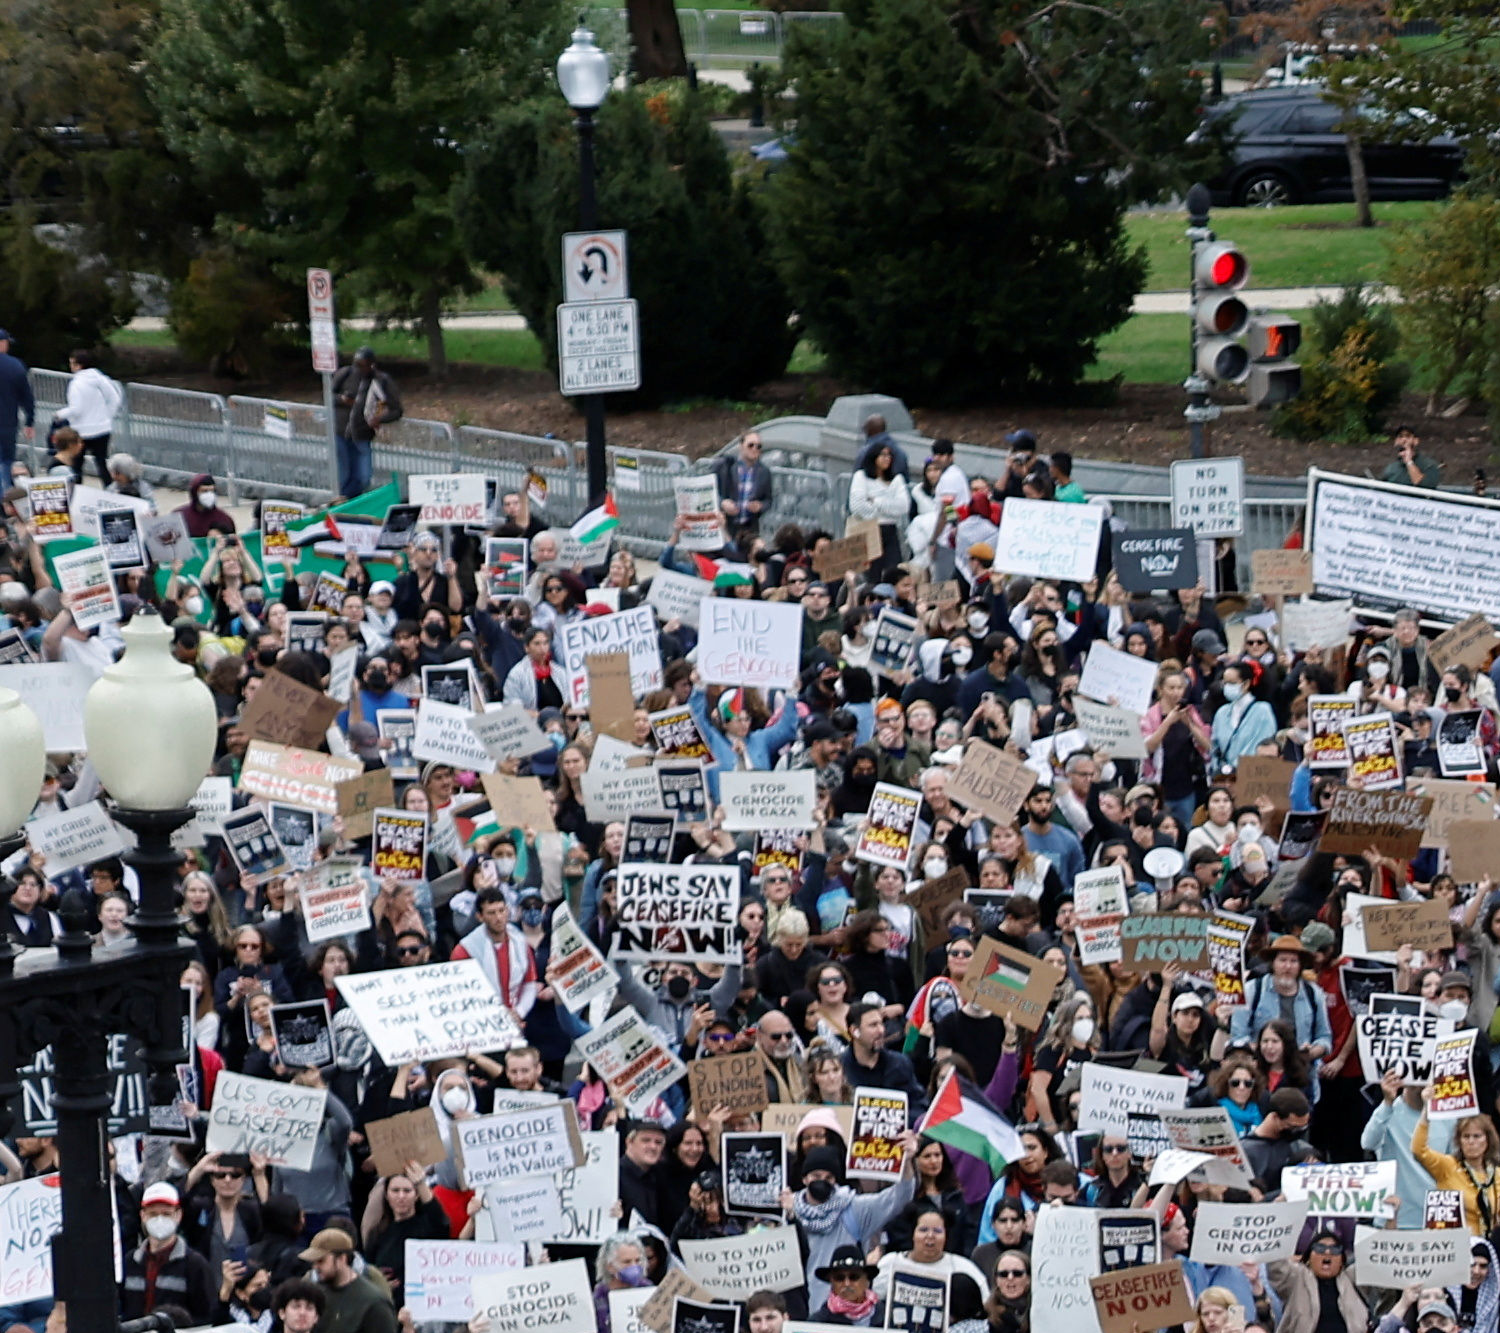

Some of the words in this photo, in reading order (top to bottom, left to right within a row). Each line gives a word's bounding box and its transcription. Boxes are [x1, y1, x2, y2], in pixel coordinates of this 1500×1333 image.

[1196, 468, 1216, 480] NO
[1190, 486, 1227, 498] TURN
[1180, 504, 1199, 515] ON
[623, 873, 679, 897] JEWS
[689, 875, 732, 898] SAY
[622, 899, 730, 923] CEASEFIRE
[464, 1116, 555, 1147] GENOCIDE
[505, 1142, 538, 1159] NOT
[469, 1164, 519, 1185] Jewish
[523, 1151, 566, 1173] Value
